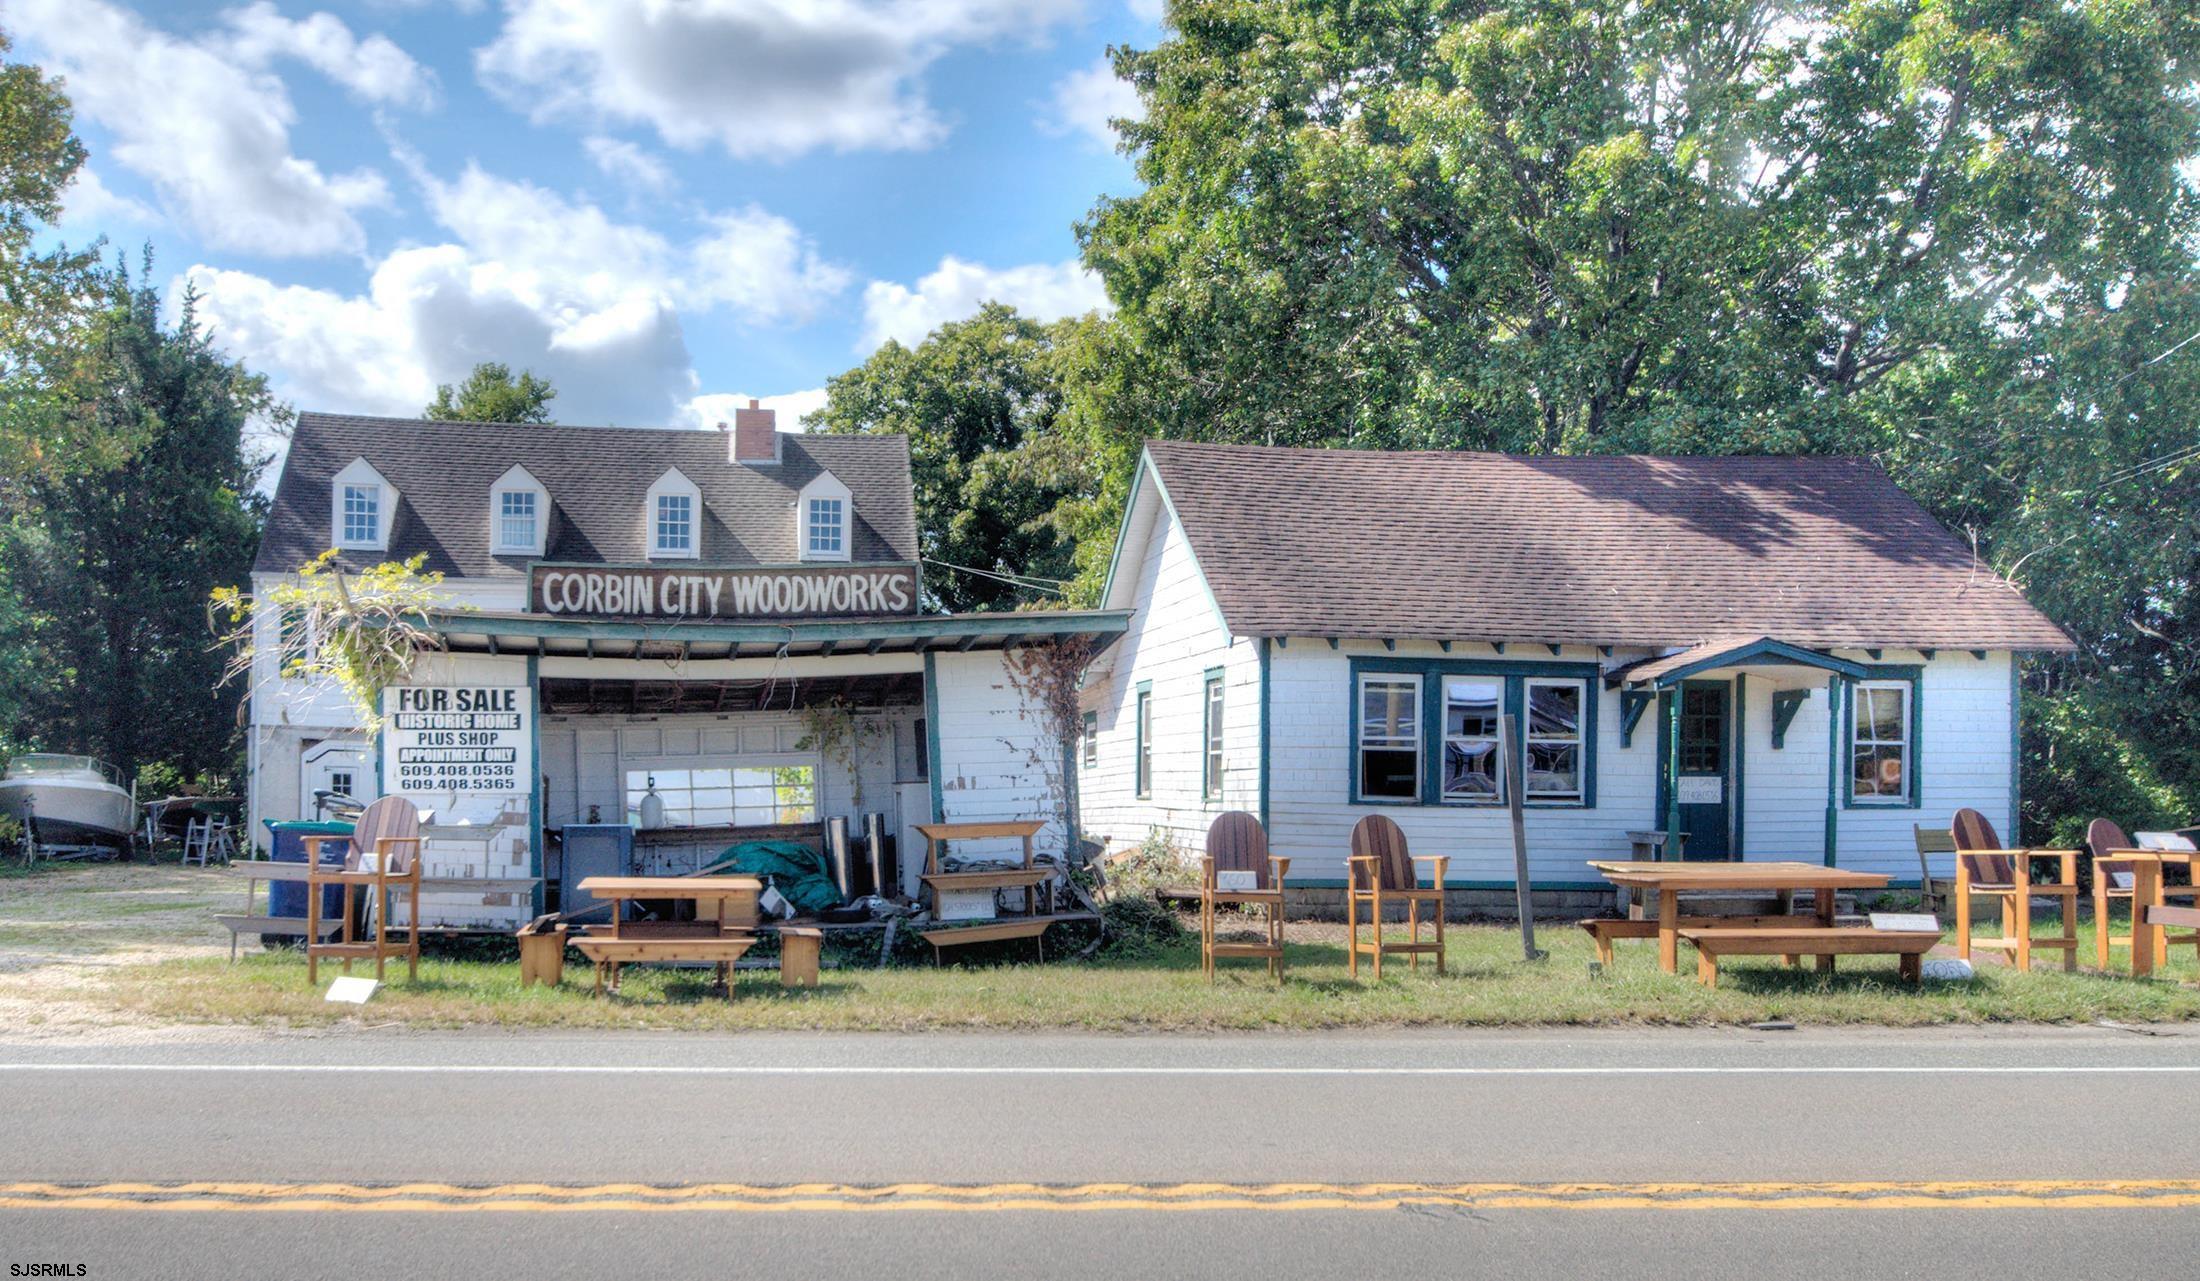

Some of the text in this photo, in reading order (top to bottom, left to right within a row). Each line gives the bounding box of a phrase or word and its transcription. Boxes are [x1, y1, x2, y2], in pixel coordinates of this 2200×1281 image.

[542, 572, 909, 614] CORBIN CITY WOODWORKS
[400, 688, 516, 712] FOR SALE
[398, 714, 518, 729] HISTORIC HOME
[418, 732, 499, 746] PLUS SHOP
[400, 748, 515, 762] APPOINTMENT ONLY
[401, 765, 514, 777] 609.408.0536
[402, 779, 515, 790] 609.408.5365
